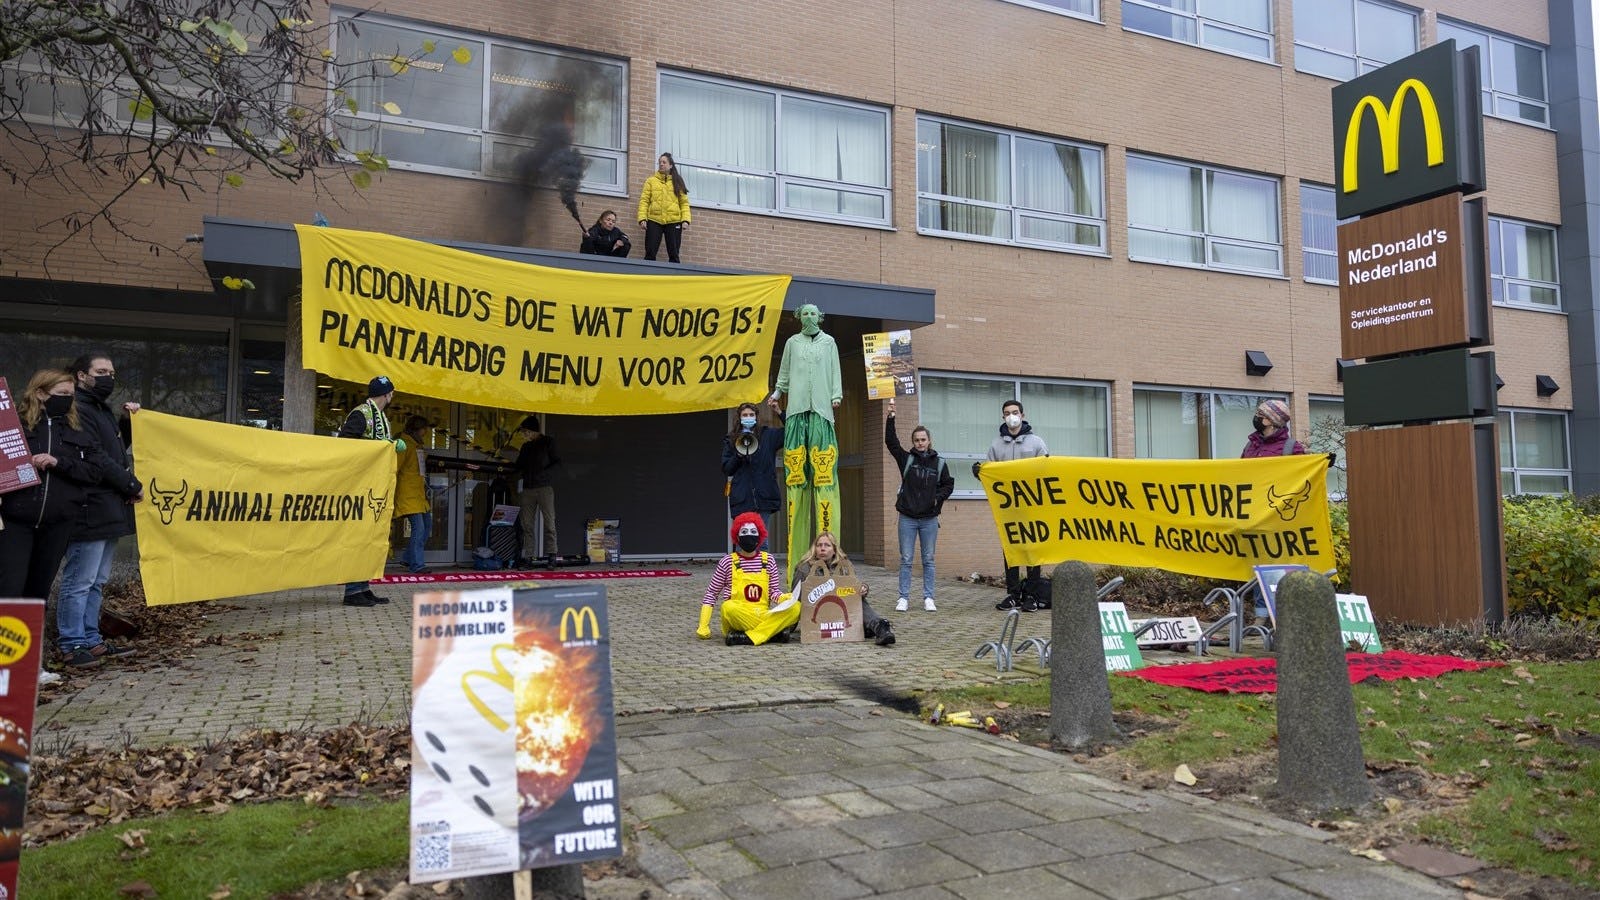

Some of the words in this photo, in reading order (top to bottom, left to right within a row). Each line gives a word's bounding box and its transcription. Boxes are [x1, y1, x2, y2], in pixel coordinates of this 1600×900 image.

[1348, 229, 1448, 265] McDonald's
[1349, 251, 1437, 285] Nederland
[324, 257, 492, 322] MCDONALD'S
[505, 295, 555, 333] DOE
[572, 304, 632, 338] WAT
[641, 307, 719, 339] NODIG
[731, 304, 766, 335] IS!
[1351, 300, 1417, 319] Servicekantoor
[1420, 297, 1431, 306] en
[1351, 308, 1434, 330] Opleidingscentrum
[319, 310, 506, 377] PLANTAARDIG
[519, 350, 602, 387] MENU
[618, 356, 686, 387] VOOR
[699, 351, 756, 384] 2025
[186, 489, 273, 521] ANIMAL
[280, 493, 364, 522] REBELLION
[992, 477, 1067, 509] SAVE
[1077, 479, 1135, 509] OUR
[1142, 483, 1253, 520] FUTURE
[1004, 520, 1050, 545] END
[1058, 518, 1145, 546] ANIMAL
[1154, 525, 1319, 559] AGRICULTURE
[419, 600, 507, 617] MCDONALD'S
[419, 626, 434, 639] IS
[435, 622, 506, 638] GAMBLING
[1151, 621, 1187, 640] JUSTICE
[573, 779, 614, 802] WITH
[583, 803, 616, 826] OUR
[554, 829, 617, 855] FUTURE
